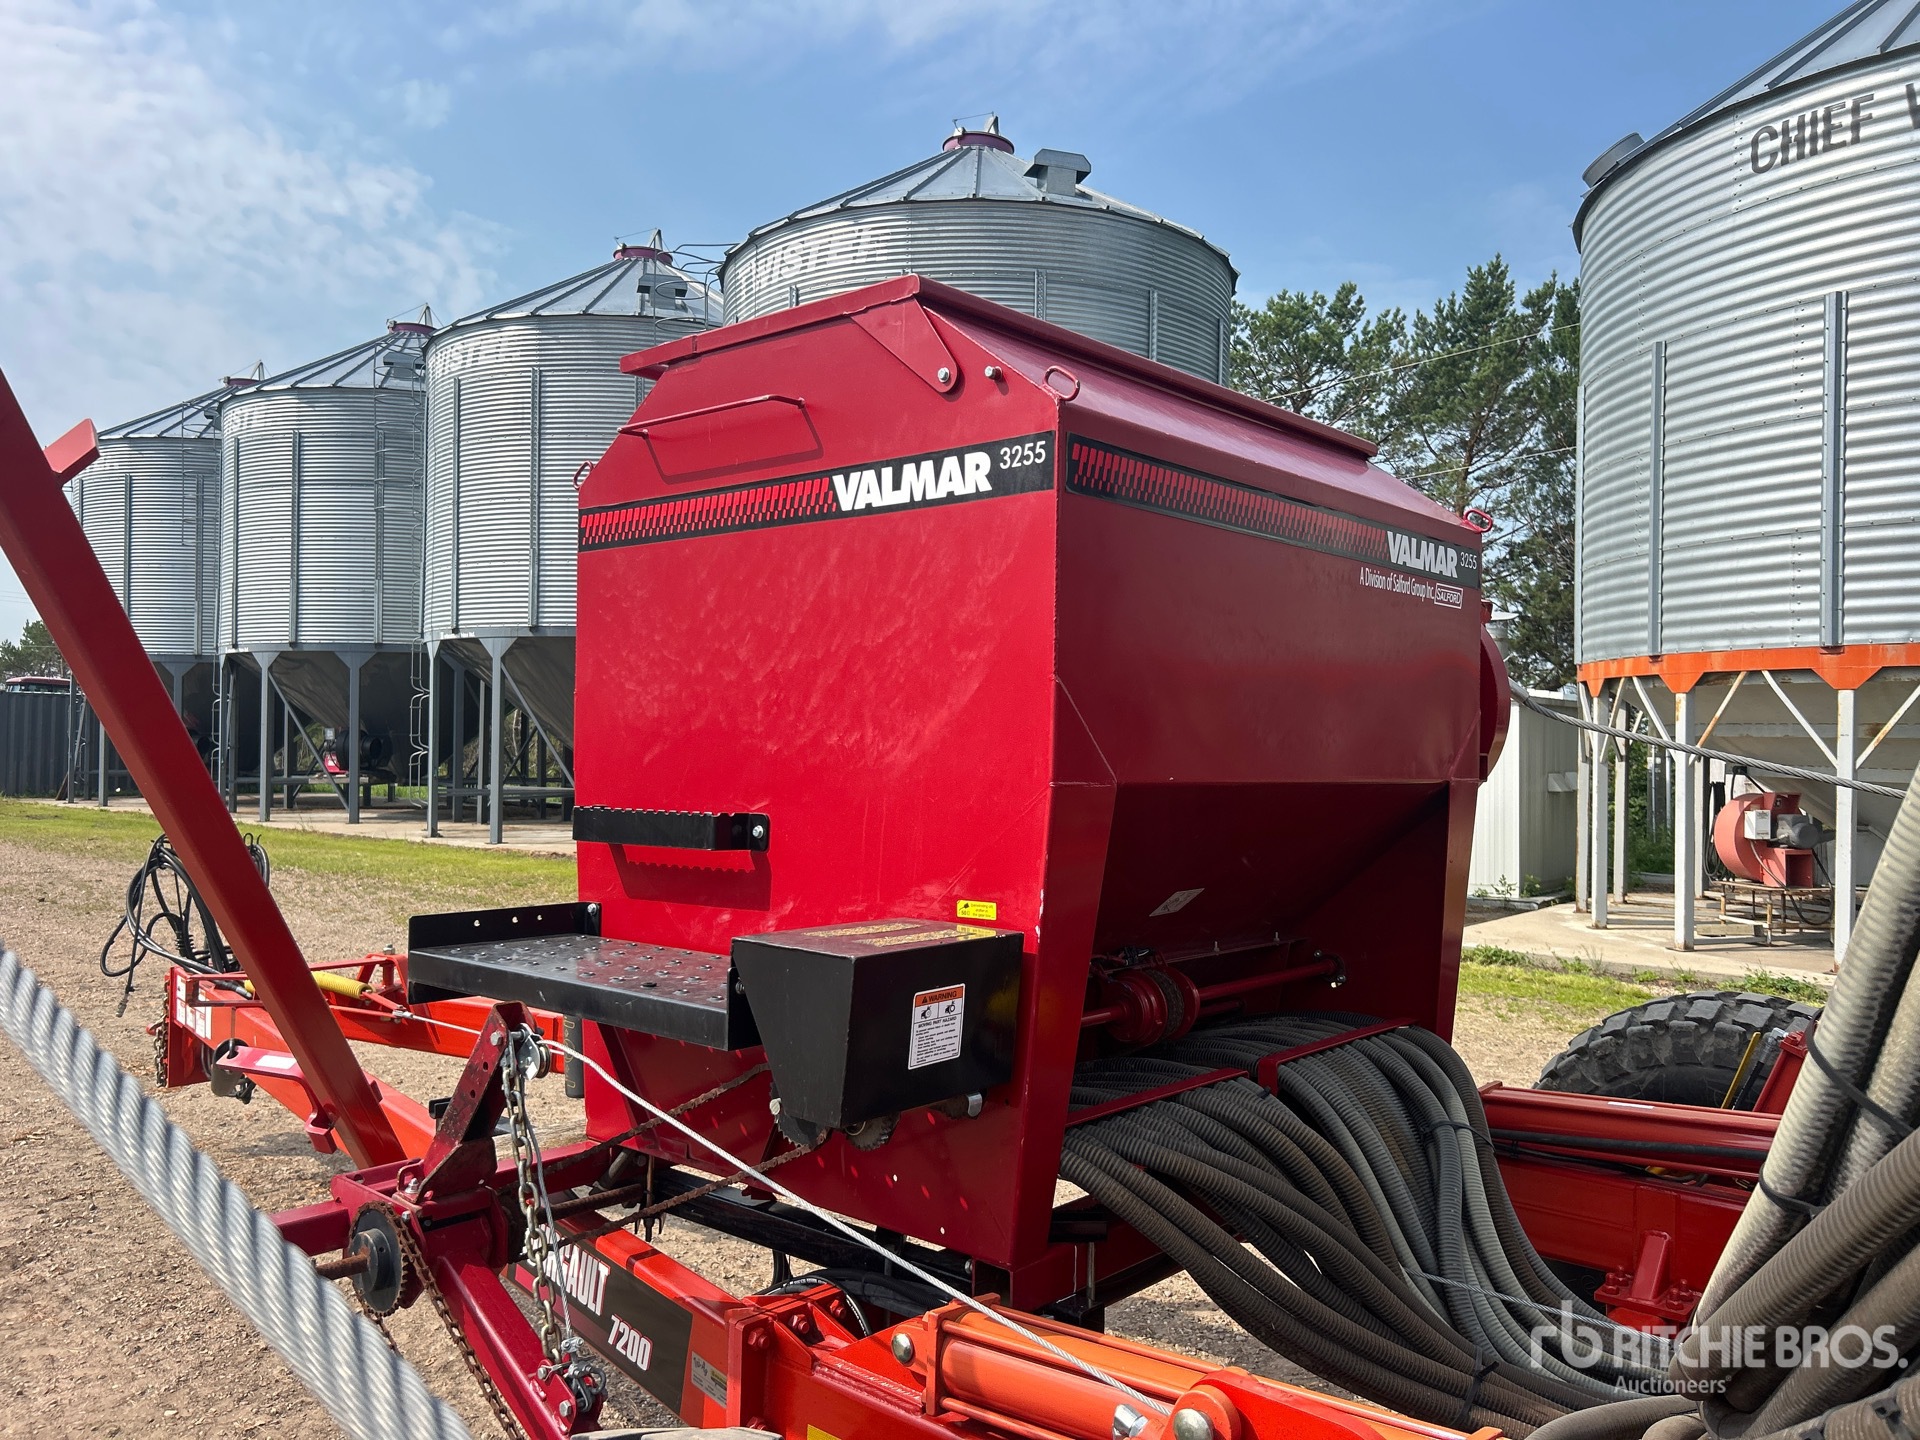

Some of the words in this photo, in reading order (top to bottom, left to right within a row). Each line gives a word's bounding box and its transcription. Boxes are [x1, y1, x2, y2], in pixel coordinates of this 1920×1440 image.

[1751, 93, 1875, 174] CHIEF
[832, 451, 992, 512] VALMAR
[999, 440, 1047, 470] 3255
[1386, 530, 1458, 579] VALMAR
[1460, 551, 1478, 570] 3255
[1359, 566, 1365, 586] A
[1365, 567, 1386, 590] Division
[1386, 572, 1394, 591] of
[1393, 573, 1411, 594] Salford
[1410, 577, 1426, 602] Group
[1436, 588, 1461, 605] SALFORD
[928, 990, 958, 1002] WARNING
[607, 1313, 653, 1371] 7200
